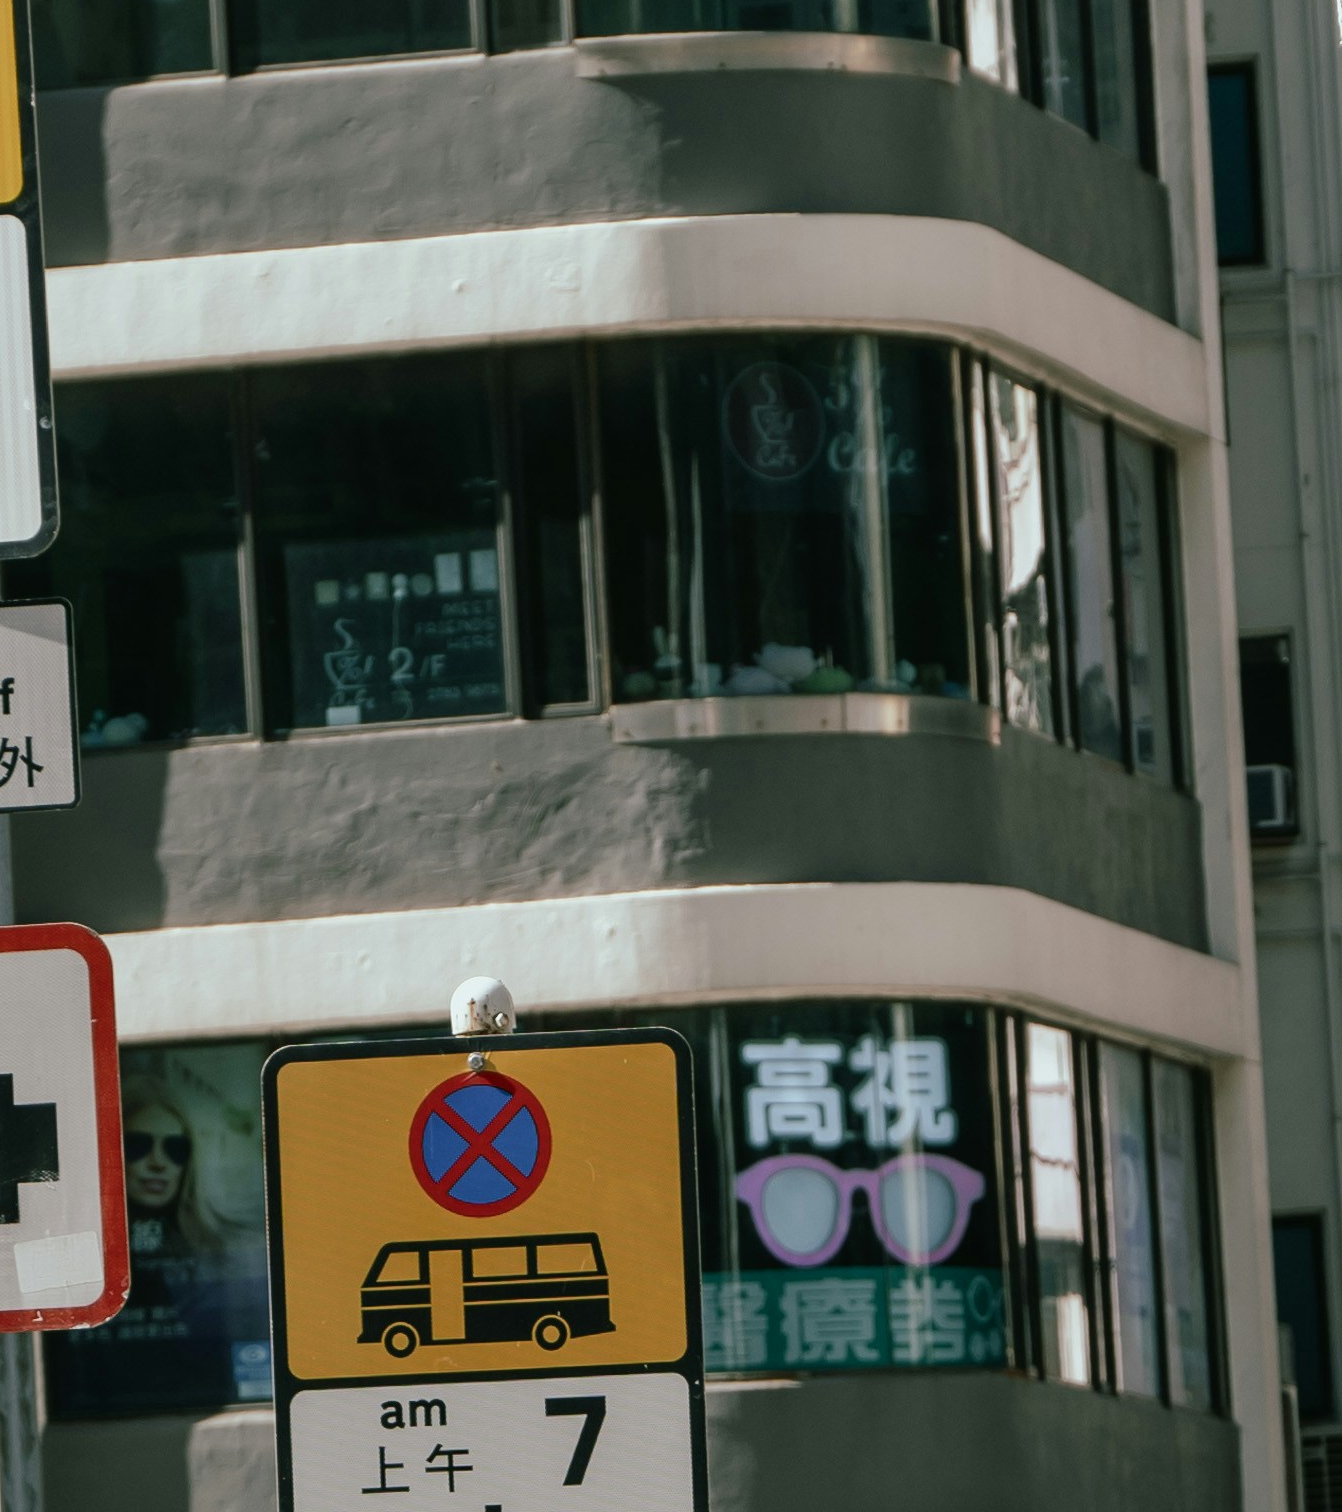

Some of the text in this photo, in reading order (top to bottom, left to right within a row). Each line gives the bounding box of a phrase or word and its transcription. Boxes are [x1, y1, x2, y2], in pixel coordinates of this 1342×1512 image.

[361, 1443, 474, 1495] 上午
[380, 1395, 606, 1486] am 7
